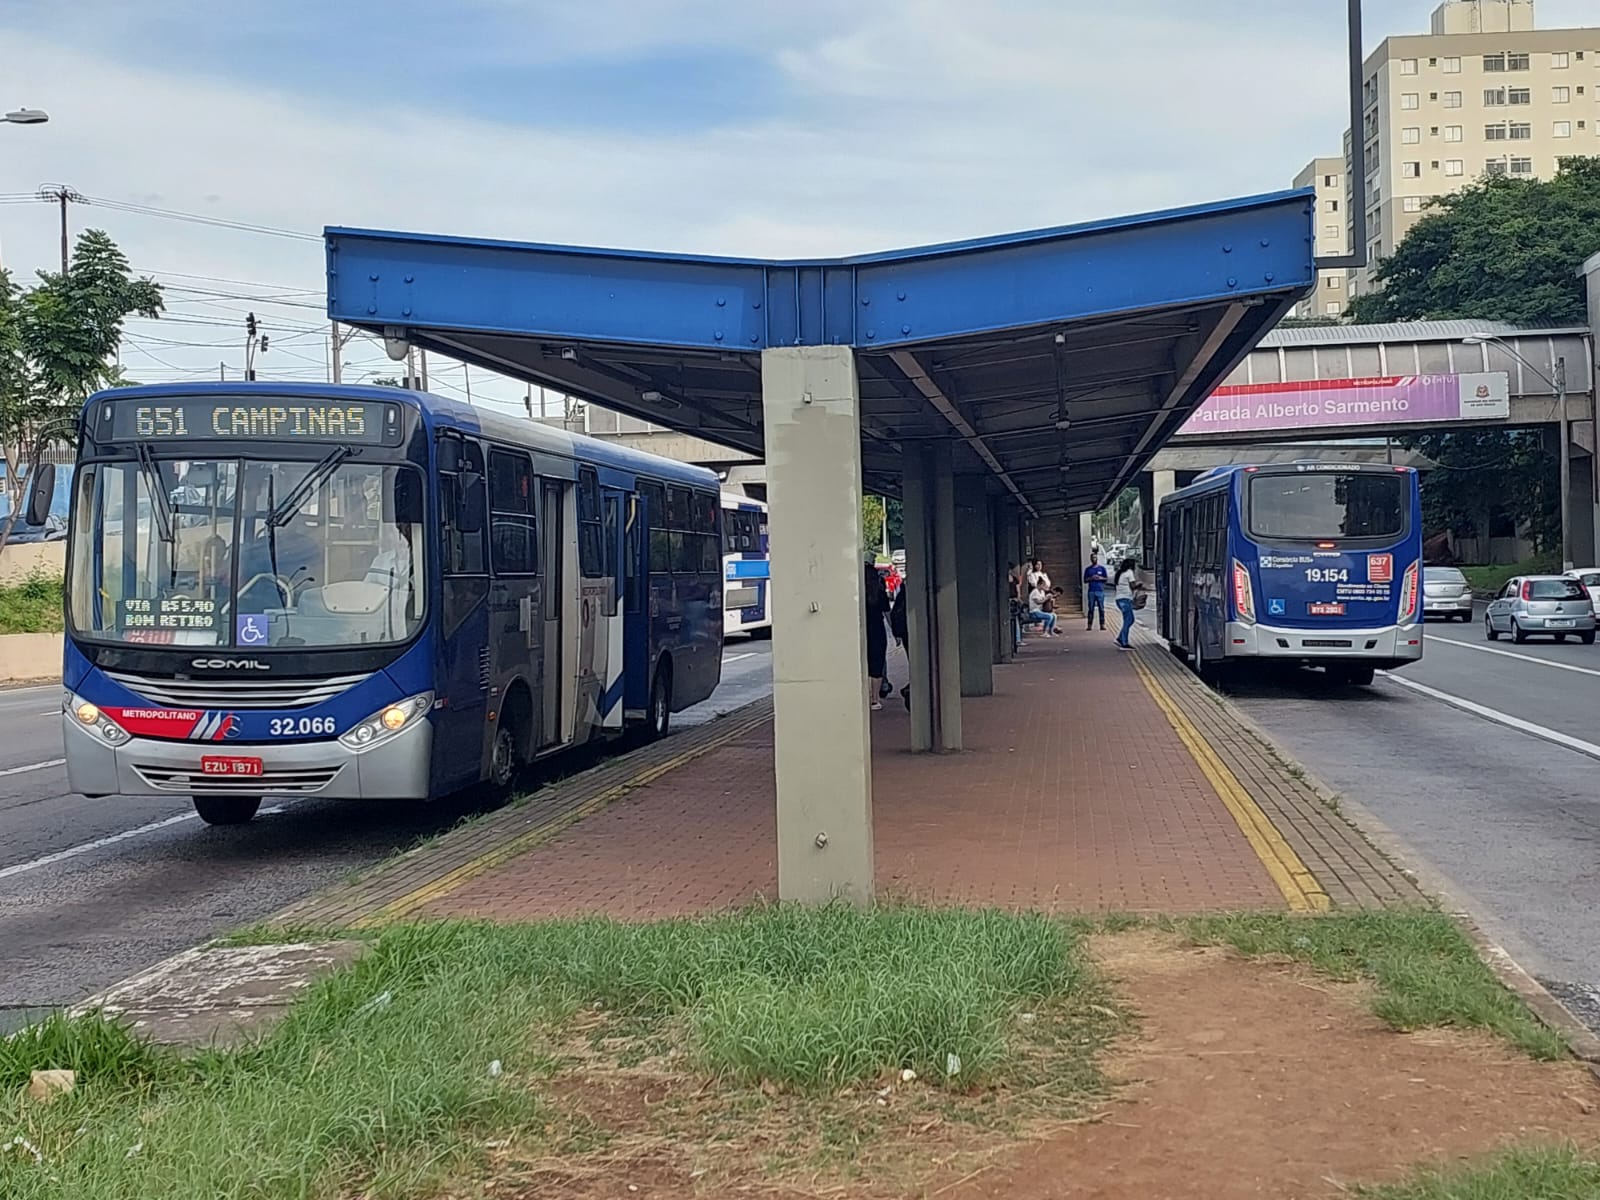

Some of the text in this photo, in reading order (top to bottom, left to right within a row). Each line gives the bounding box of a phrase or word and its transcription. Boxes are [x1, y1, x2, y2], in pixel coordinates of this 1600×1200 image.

[1192, 398, 1408, 422] Parada Alberto Sarmento
[136, 407, 365, 435] 651 CAMPINAS
[1370, 556, 1388, 566] 637
[1304, 568, 1348, 582] 19.154
[125, 600, 151, 611] VIA
[125, 614, 214, 627] BOM RETIRO
[191, 659, 270, 669] COMIL
[122, 709, 197, 721] METROPOLITANO
[269, 717, 336, 735] 32.066
